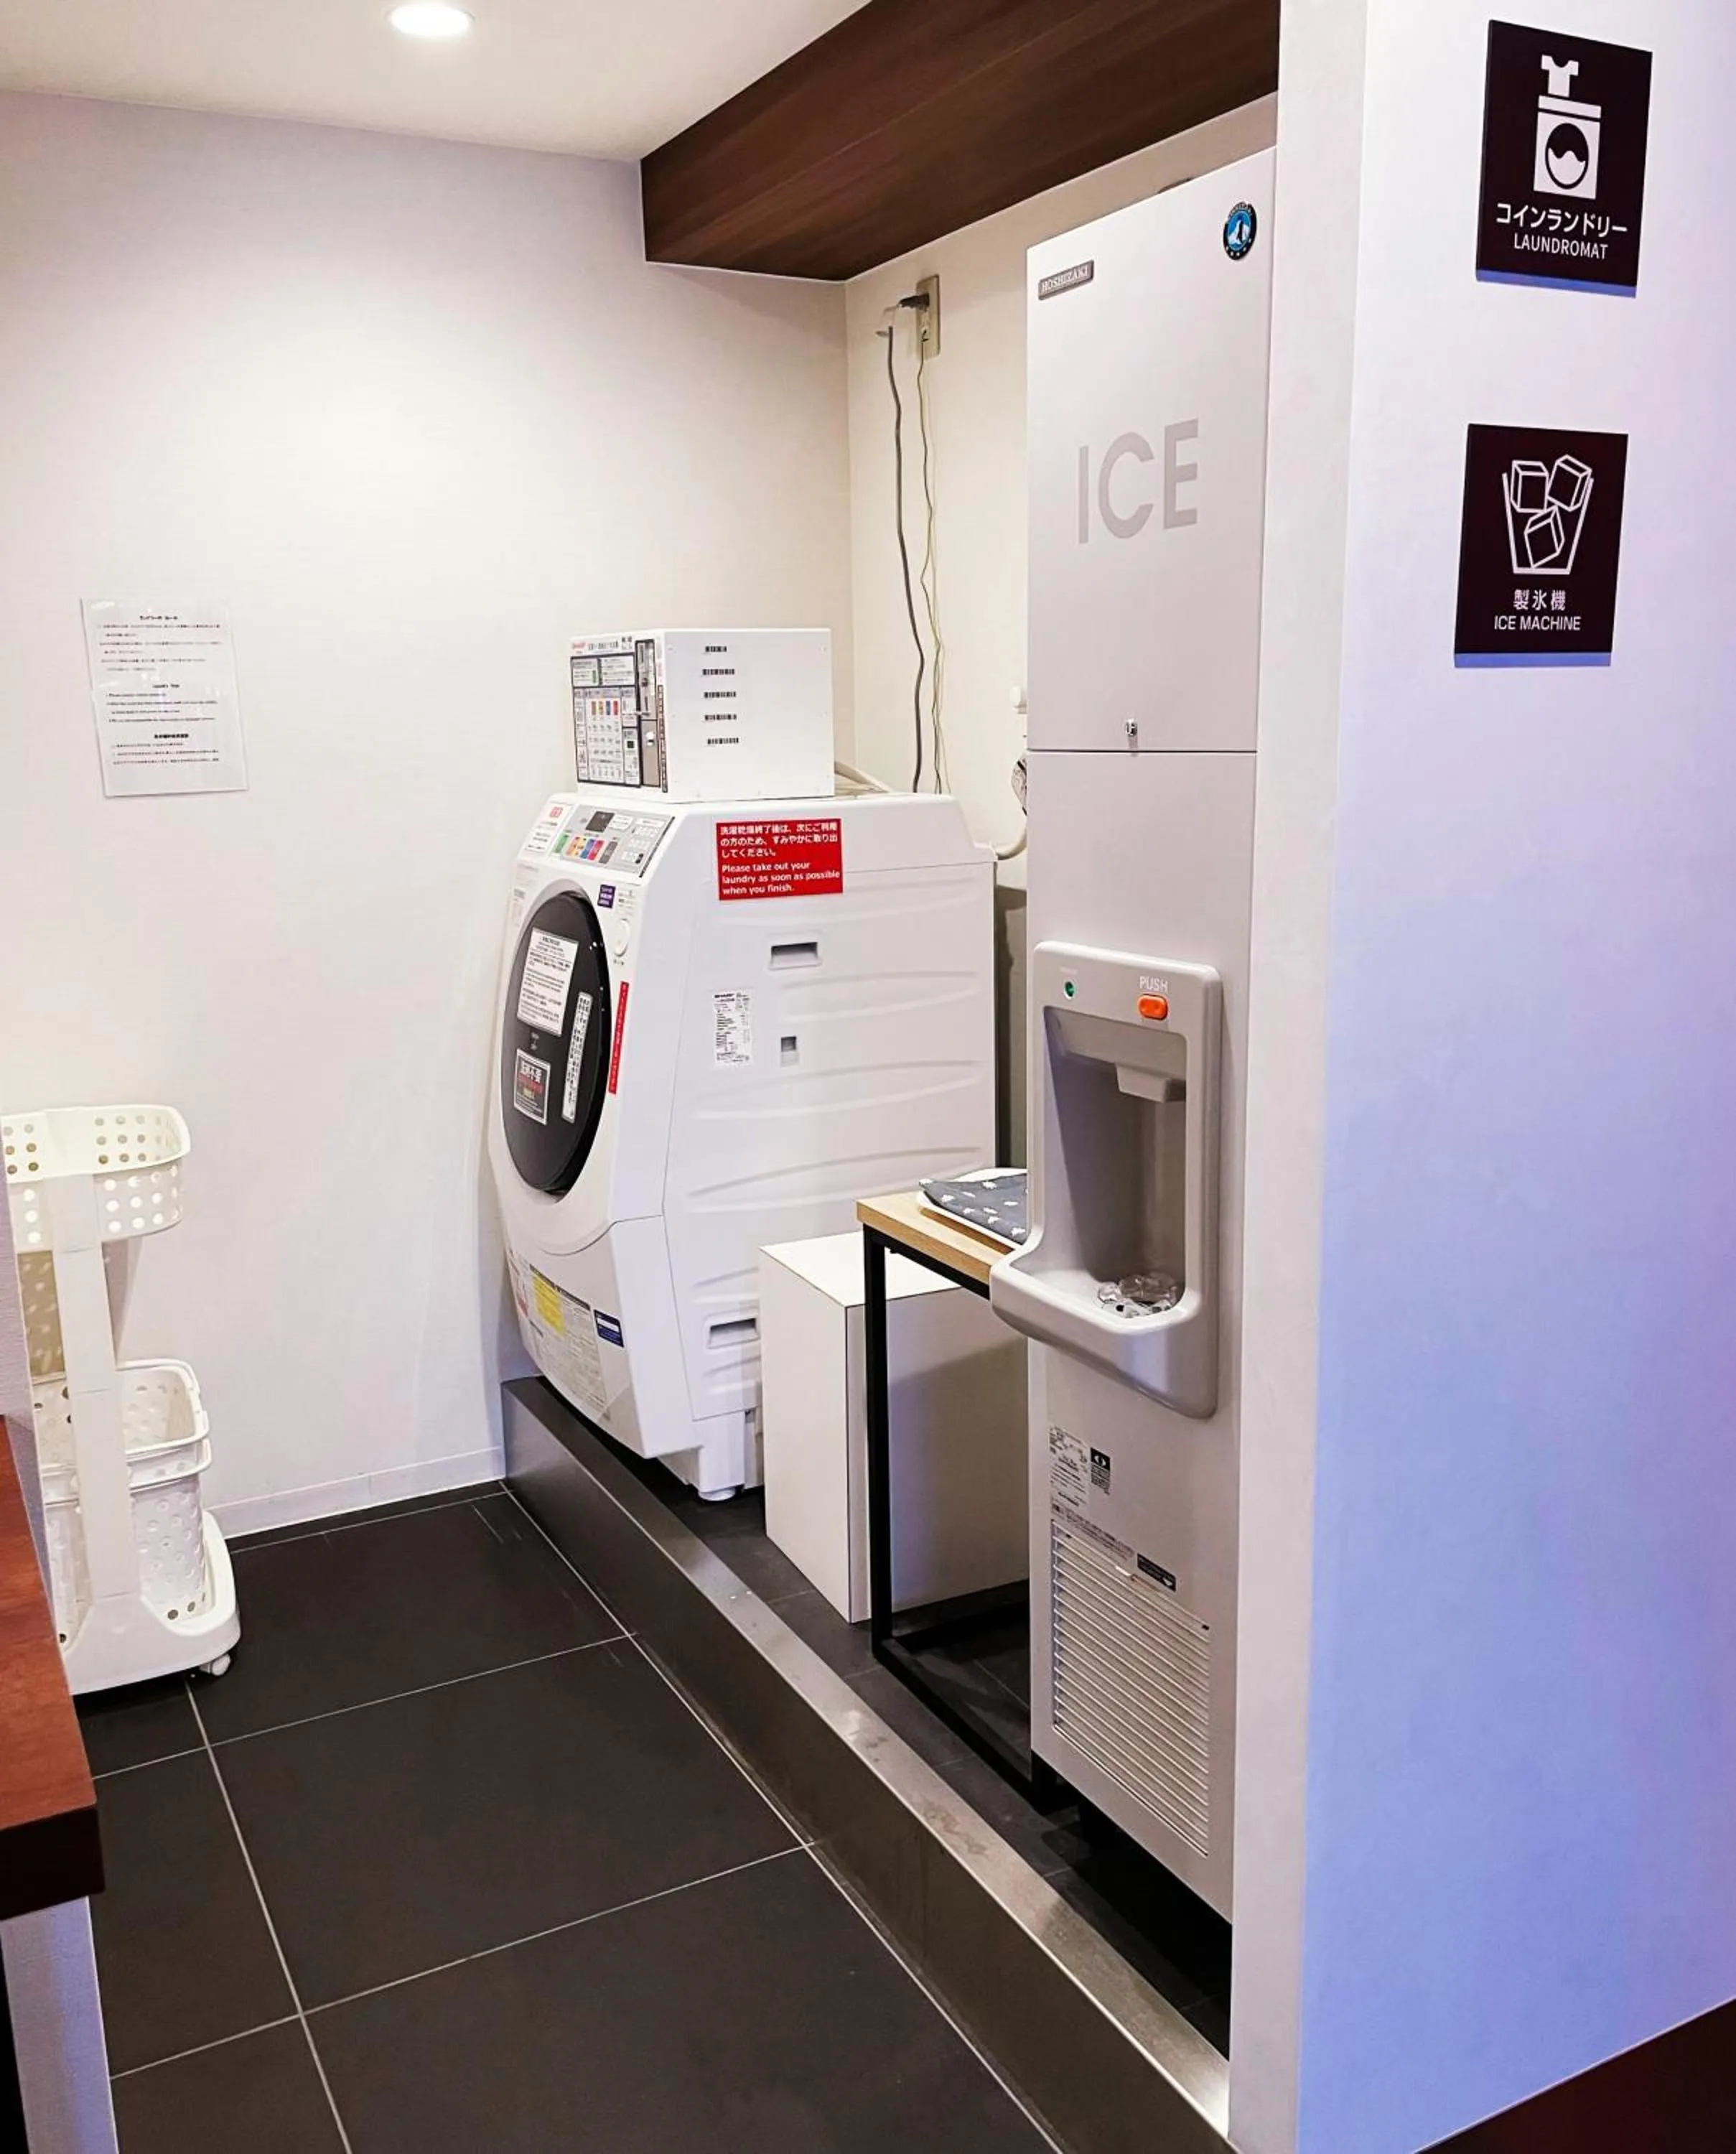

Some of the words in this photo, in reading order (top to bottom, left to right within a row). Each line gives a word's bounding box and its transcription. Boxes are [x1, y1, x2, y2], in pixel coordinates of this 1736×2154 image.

[1496, 202, 1628, 238] コインランドリー
[1513, 232, 1608, 259] LAUNDROMAT
[1078, 419, 1199, 544] ICE
[1513, 589, 1567, 611] 製氷機
[1494, 615, 1516, 631] ICE
[1519, 615, 1582, 631] MACHINE
[722, 864, 750, 873] Please
[752, 863, 773, 872] take
[790, 862, 811, 872] your
[722, 875, 756, 885] laundry
[770, 873, 792, 882] soon
[806, 870, 840, 881] possible
[722, 885, 747, 895] when
[749, 887, 765, 895] you
[767, 883, 795, 893] finish.
[1139, 976, 1169, 992] PUSH
